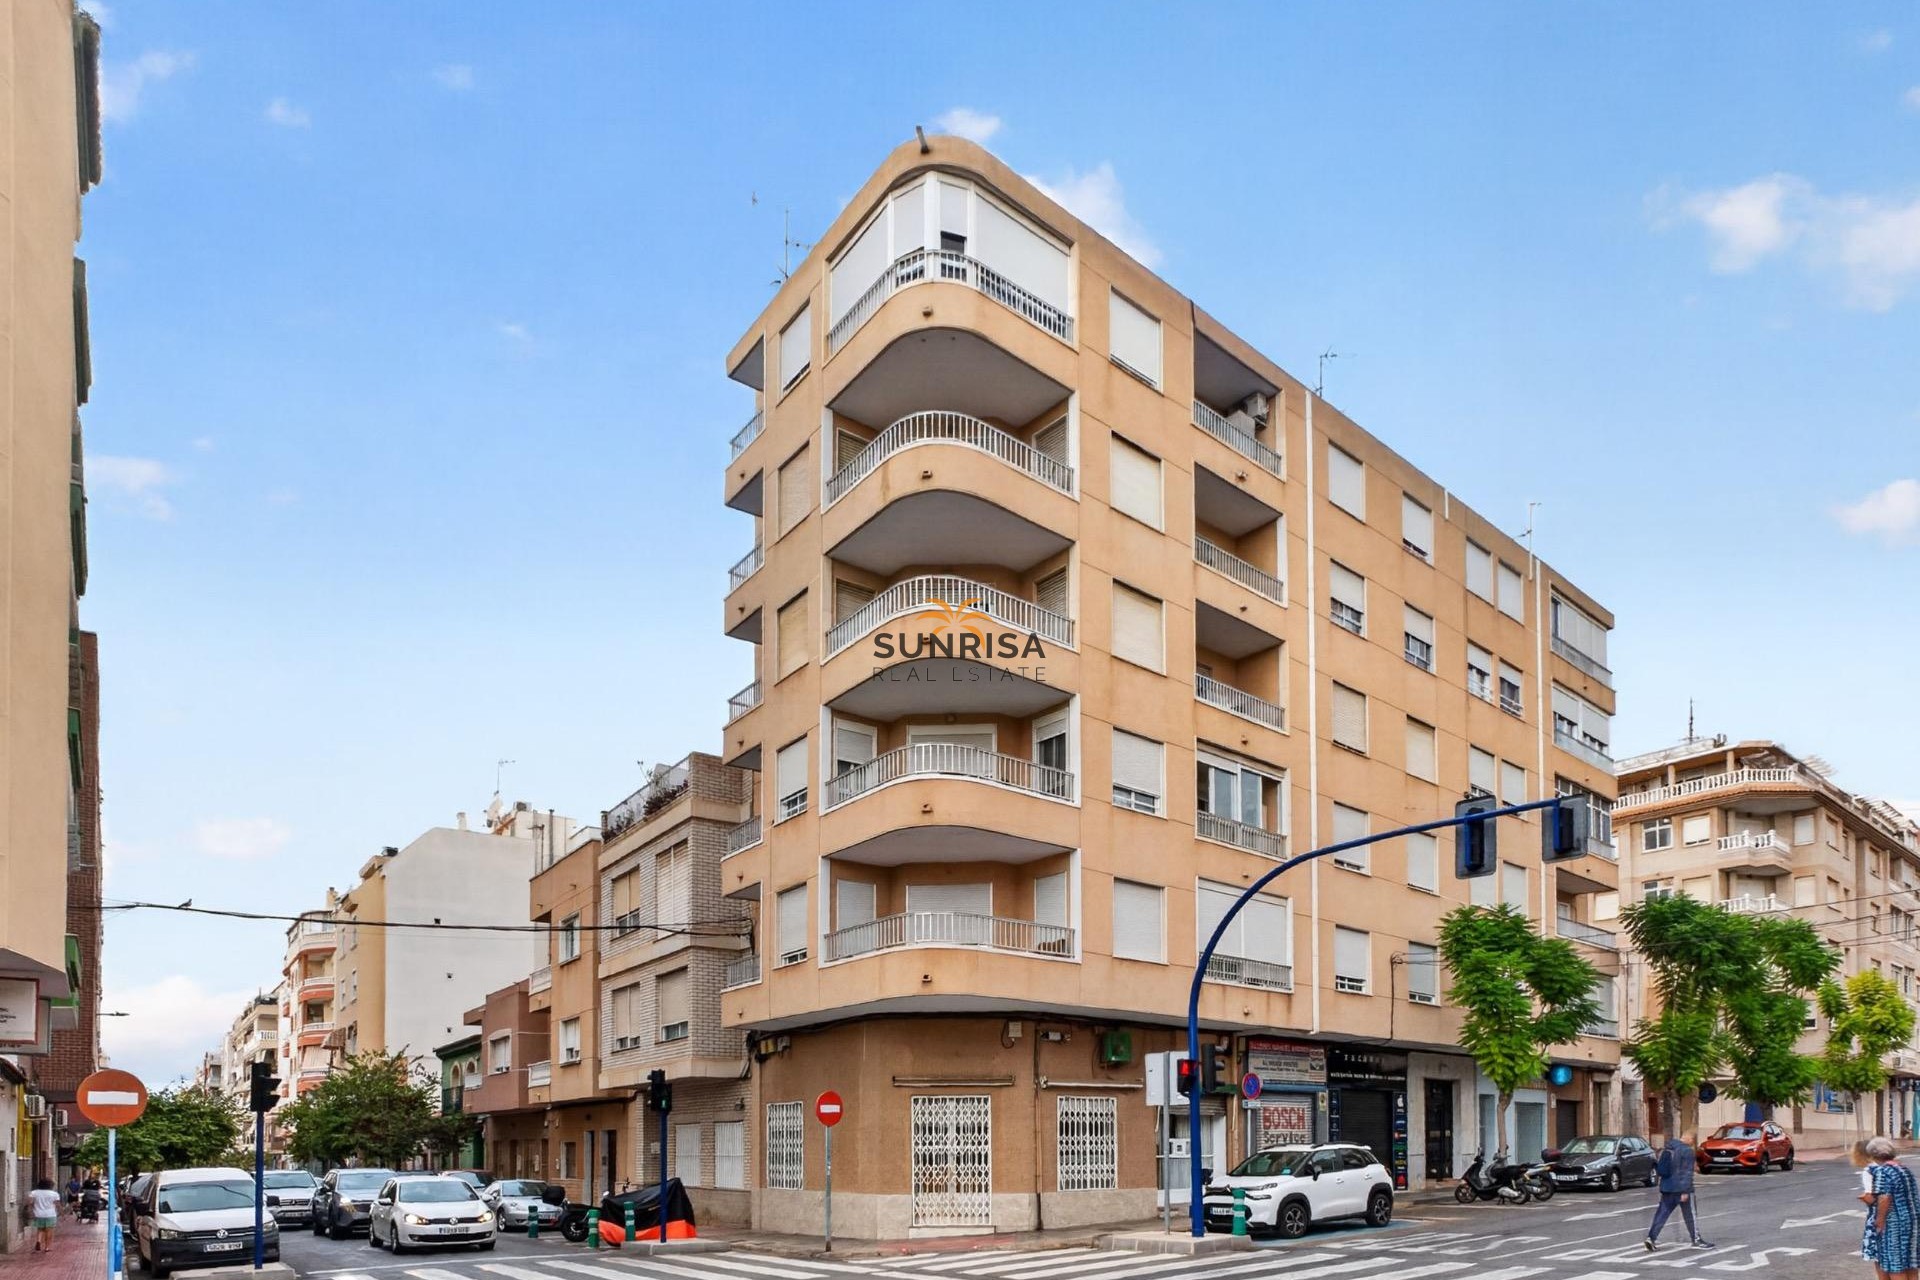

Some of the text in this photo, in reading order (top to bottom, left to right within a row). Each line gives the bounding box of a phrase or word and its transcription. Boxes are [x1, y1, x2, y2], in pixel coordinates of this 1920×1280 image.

[1263, 1106, 1306, 1130] BOSCH
[1264, 1130, 1306, 1145] Service
[1539, 1241, 1819, 1271] STOP
